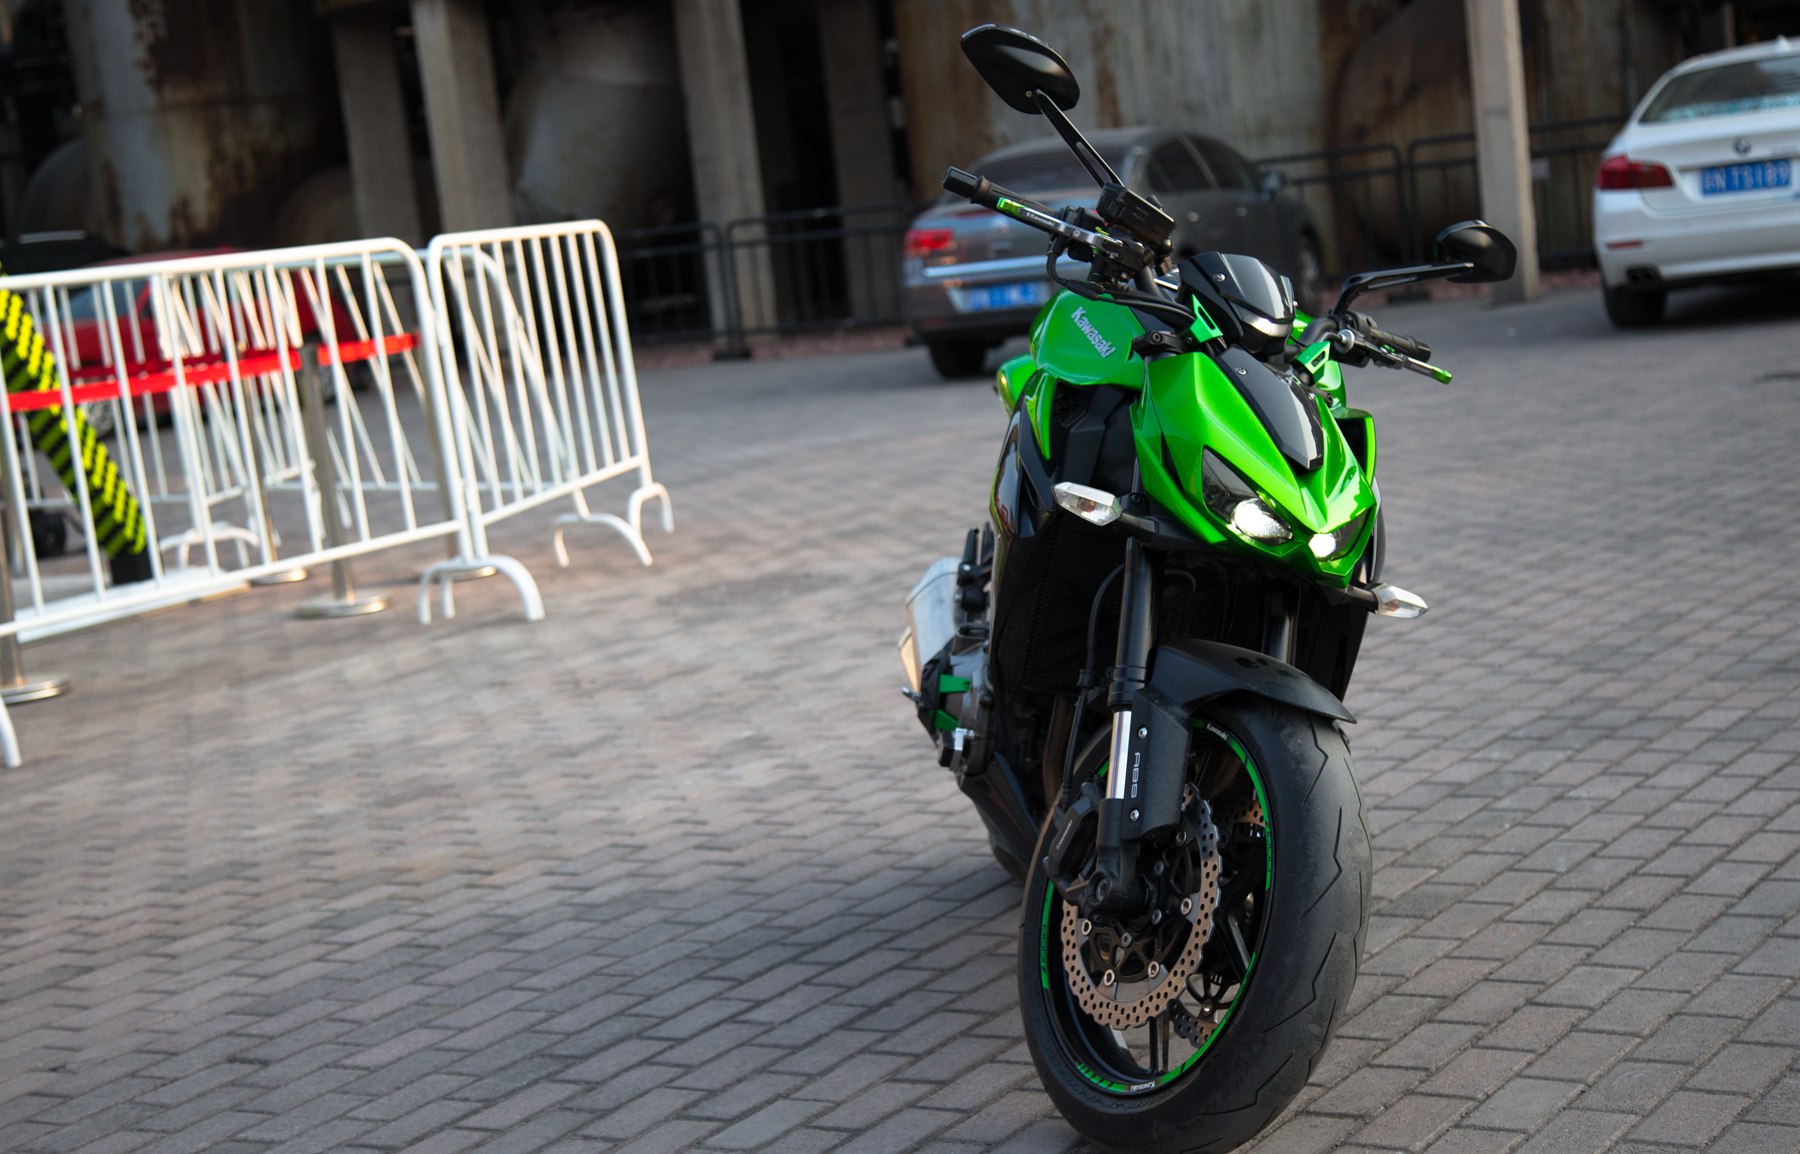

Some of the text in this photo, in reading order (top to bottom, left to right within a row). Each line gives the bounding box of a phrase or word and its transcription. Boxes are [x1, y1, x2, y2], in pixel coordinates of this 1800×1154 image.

[1071, 306, 1117, 358] Kawasaki
[1206, 723, 1228, 740] Kawasaki
[1131, 752, 1140, 798] ABS
[1131, 1081, 1156, 1092] Kawasaki
